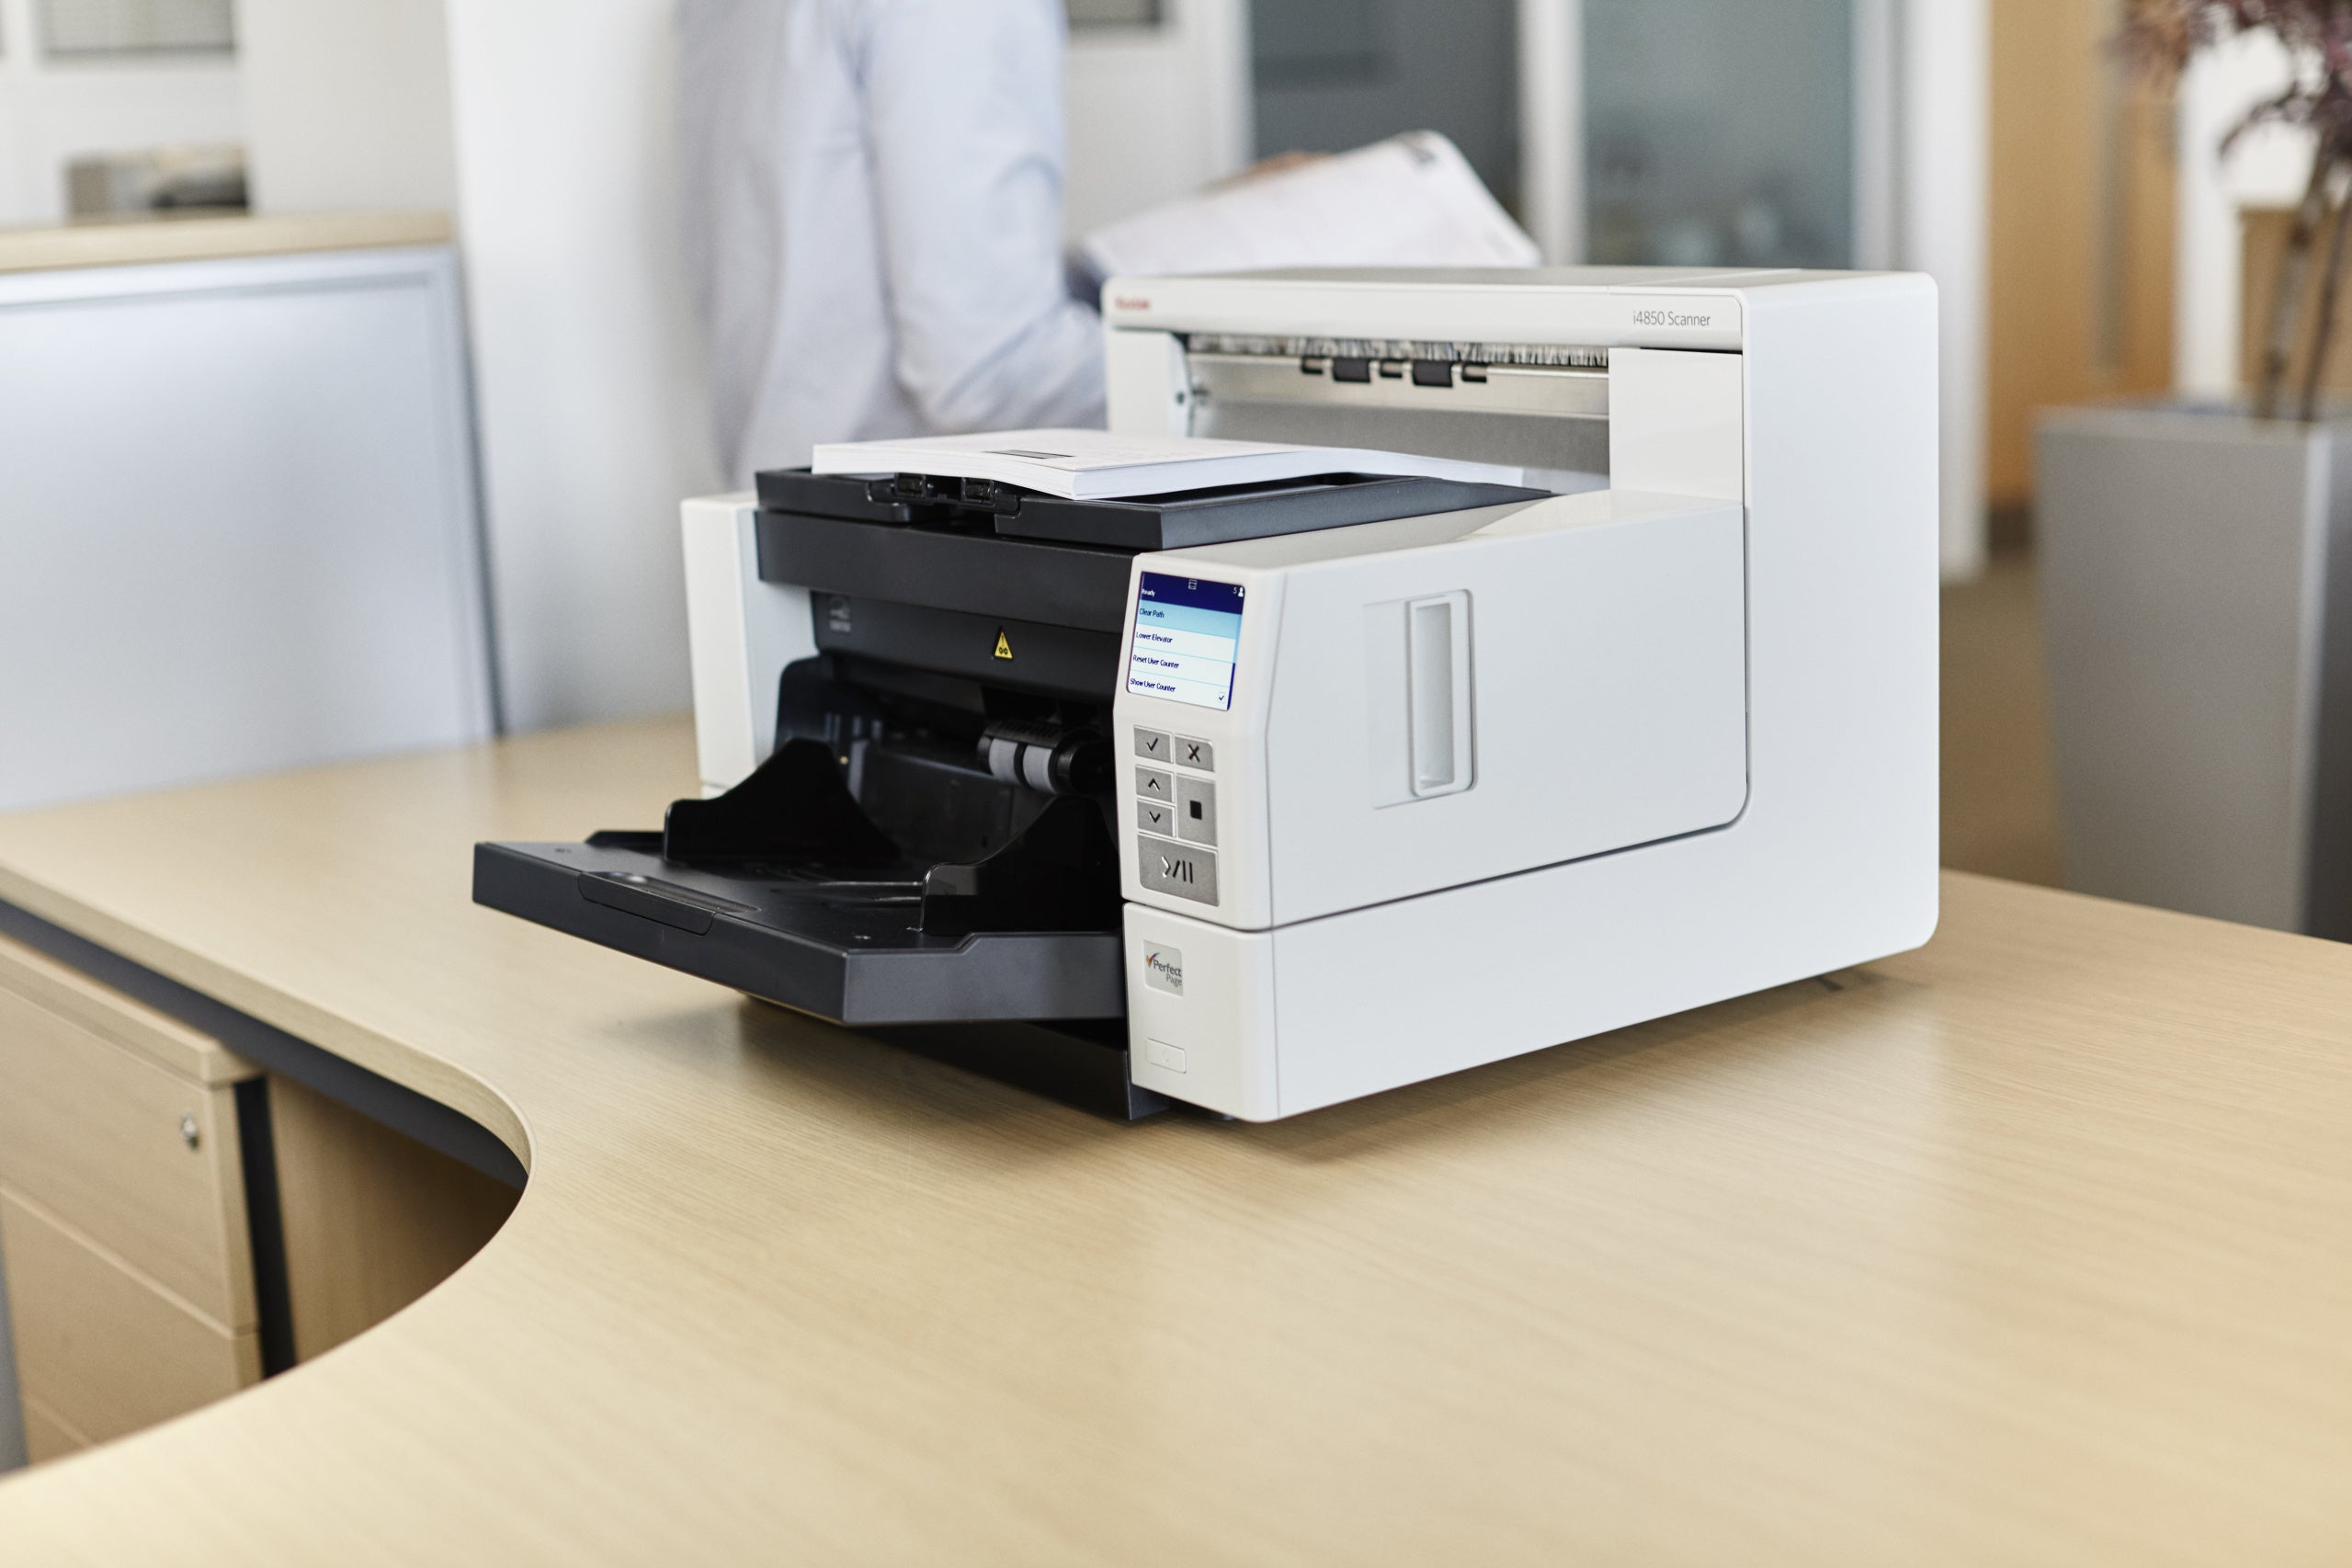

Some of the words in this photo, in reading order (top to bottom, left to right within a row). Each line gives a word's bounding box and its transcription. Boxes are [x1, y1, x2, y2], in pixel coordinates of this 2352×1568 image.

[1633, 311, 1665, 325] i4850
[1668, 311, 1710, 326] Scanner
[1140, 608, 1152, 617] Clear
[1153, 609, 1165, 618] Path
[1136, 631, 1152, 640] Lower
[1152, 634, 1173, 643] Elevator
[1132, 654, 1147, 664] Reset
[1147, 657, 1159, 665] User
[1160, 659, 1179, 669] Counter
[1131, 677, 1143, 687] Show
[1143, 680, 1155, 688] User
[1156, 682, 1176, 692] Counter
[1153, 959, 1182, 978] Perfect
[1165, 973, 1183, 987] Page
